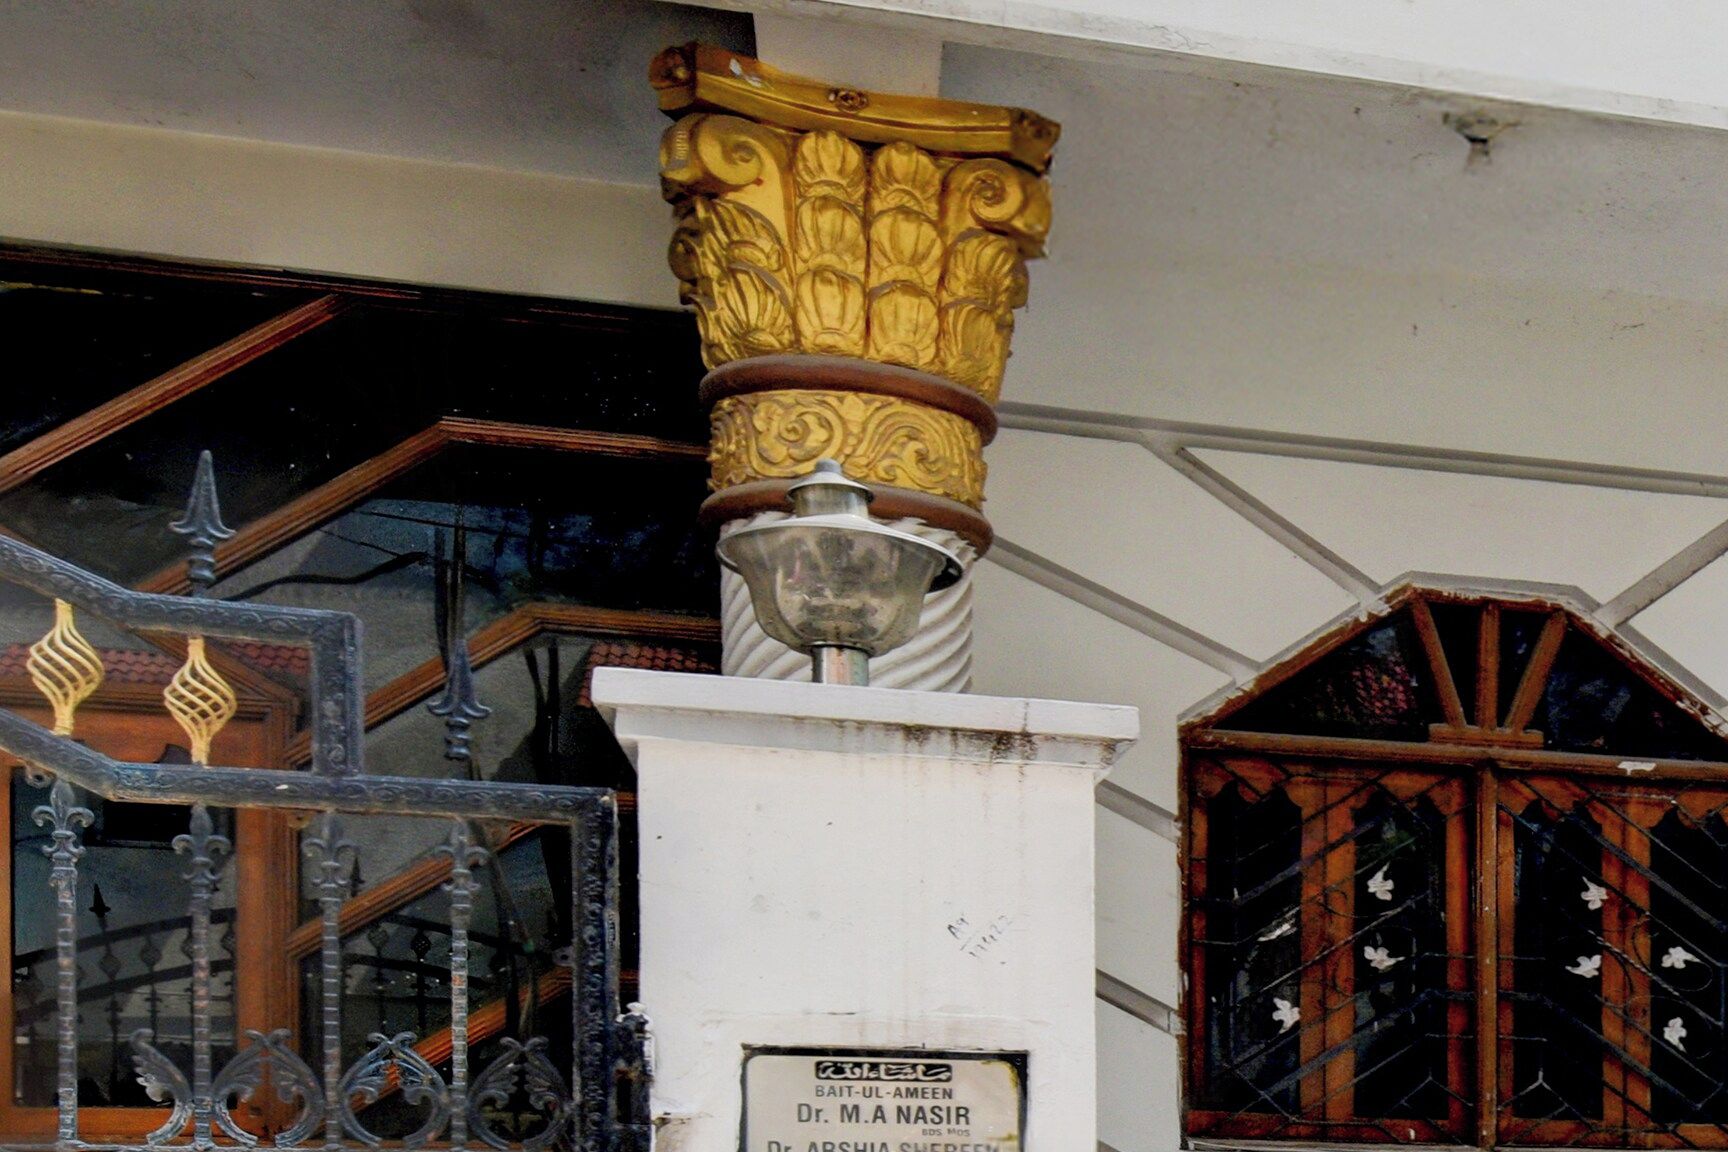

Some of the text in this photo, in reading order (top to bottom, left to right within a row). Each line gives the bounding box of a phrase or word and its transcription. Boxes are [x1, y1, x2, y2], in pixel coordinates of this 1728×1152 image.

[815, 1085, 953, 1099] BAIT-UL-AMEEN
[797, 1103, 970, 1125] Dr. M.A NASIR
